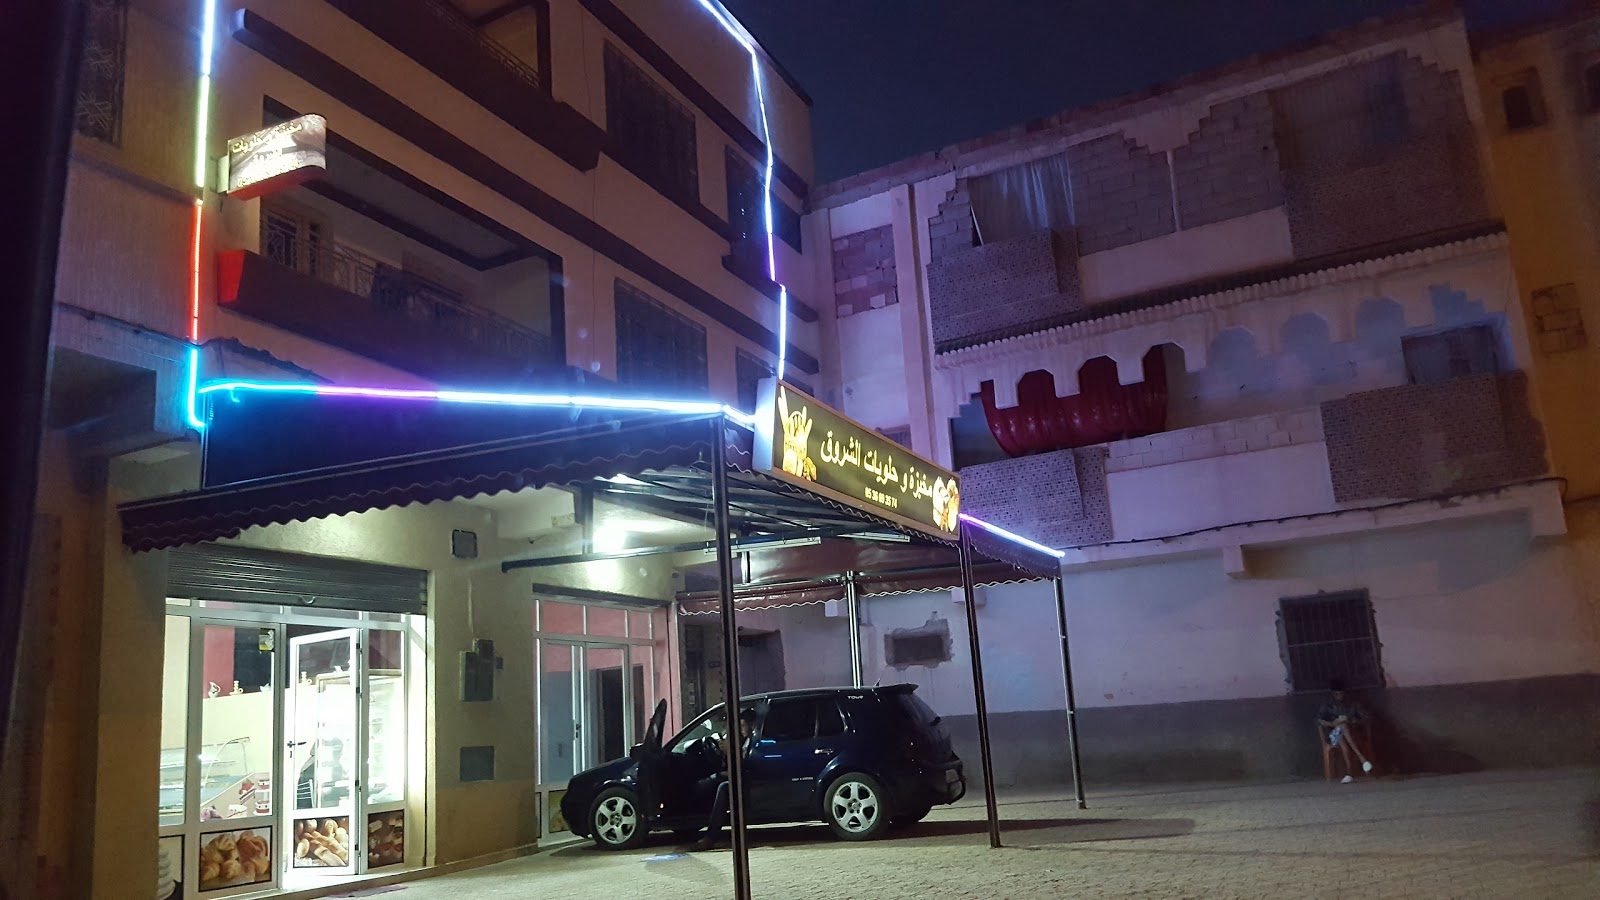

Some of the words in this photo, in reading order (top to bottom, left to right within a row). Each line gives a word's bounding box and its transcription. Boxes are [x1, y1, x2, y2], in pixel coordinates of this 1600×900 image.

[820, 430, 861, 467] الشروق
[863, 450, 899, 485] حلويات
[900, 472, 908, 493] و
[909, 466, 933, 500] مخبزة
